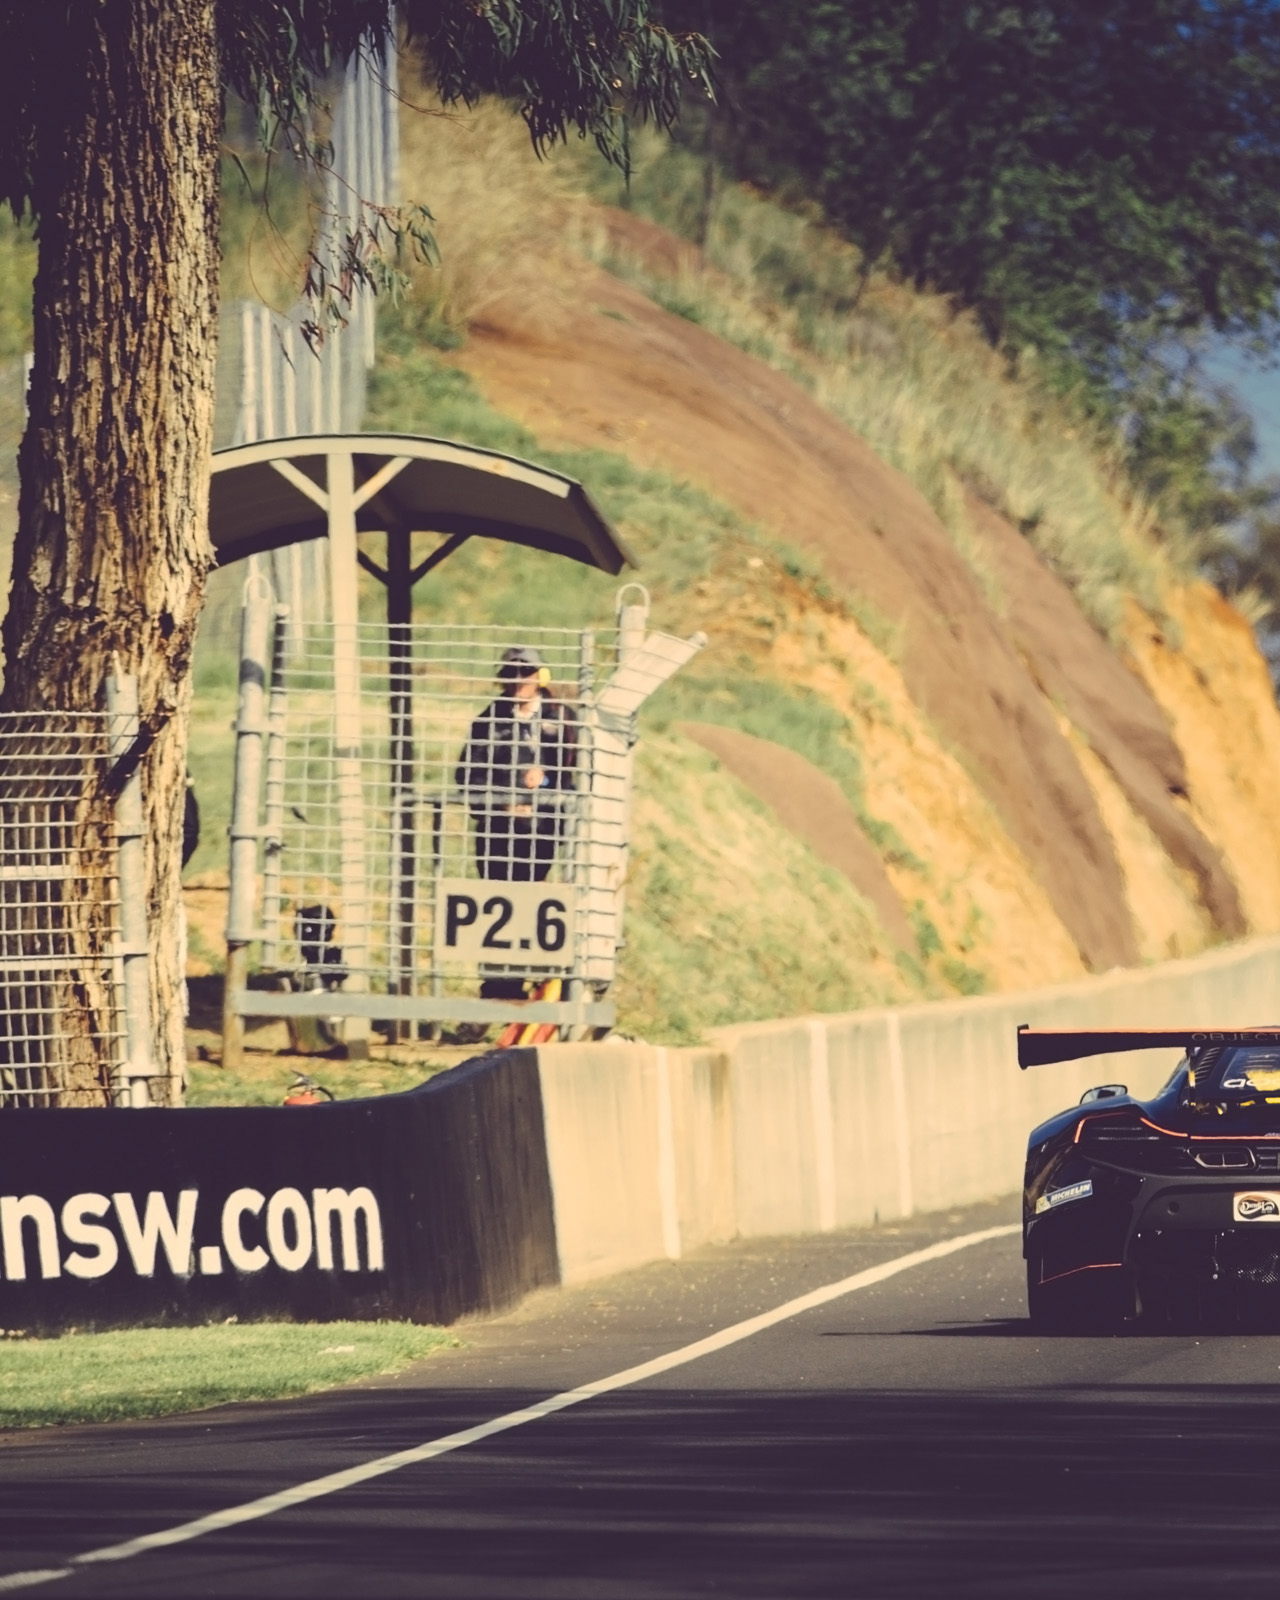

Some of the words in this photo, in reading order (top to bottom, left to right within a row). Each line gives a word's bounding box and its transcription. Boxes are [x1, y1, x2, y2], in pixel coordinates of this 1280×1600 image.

[445, 895, 566, 951] P2.6
[1051, 1184, 1090, 1204] MICHELIN
[0, 1187, 384, 1280] nsw.com
